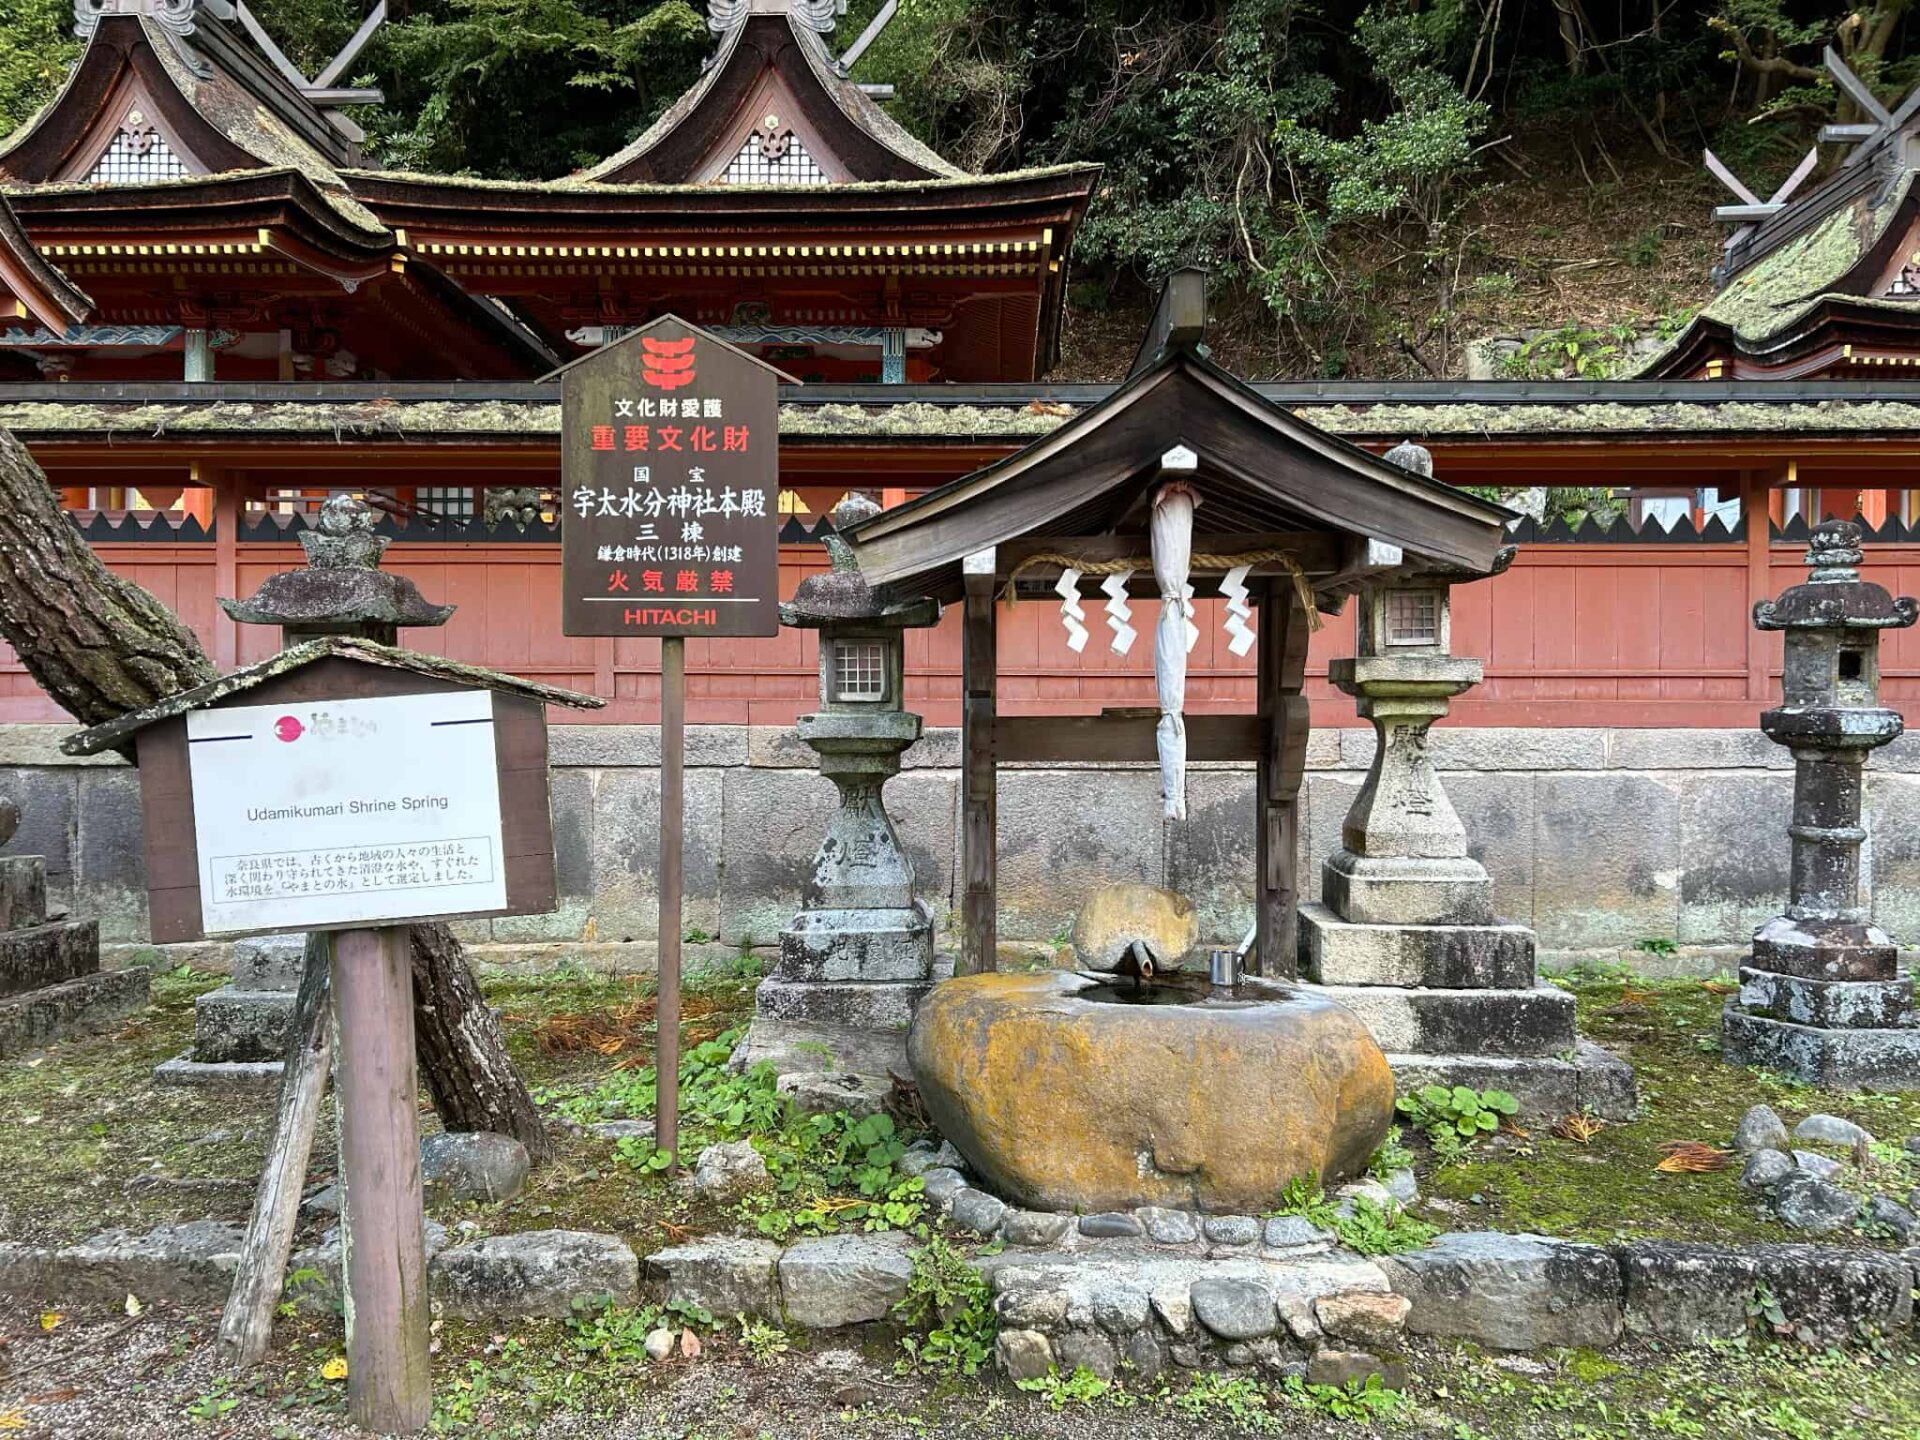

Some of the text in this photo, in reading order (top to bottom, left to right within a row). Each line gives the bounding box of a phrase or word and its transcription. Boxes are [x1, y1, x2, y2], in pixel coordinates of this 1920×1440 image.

[614, 398, 723, 418] 文化財愛護
[591, 424, 750, 451] 重要文化財
[572, 485, 767, 519] 宇太水分神社本殿
[608, 569, 733, 592] 火気厳禁
[624, 608, 717, 625] HITACHI
[247, 795, 448, 822] Udamikumari Shrine Spring
